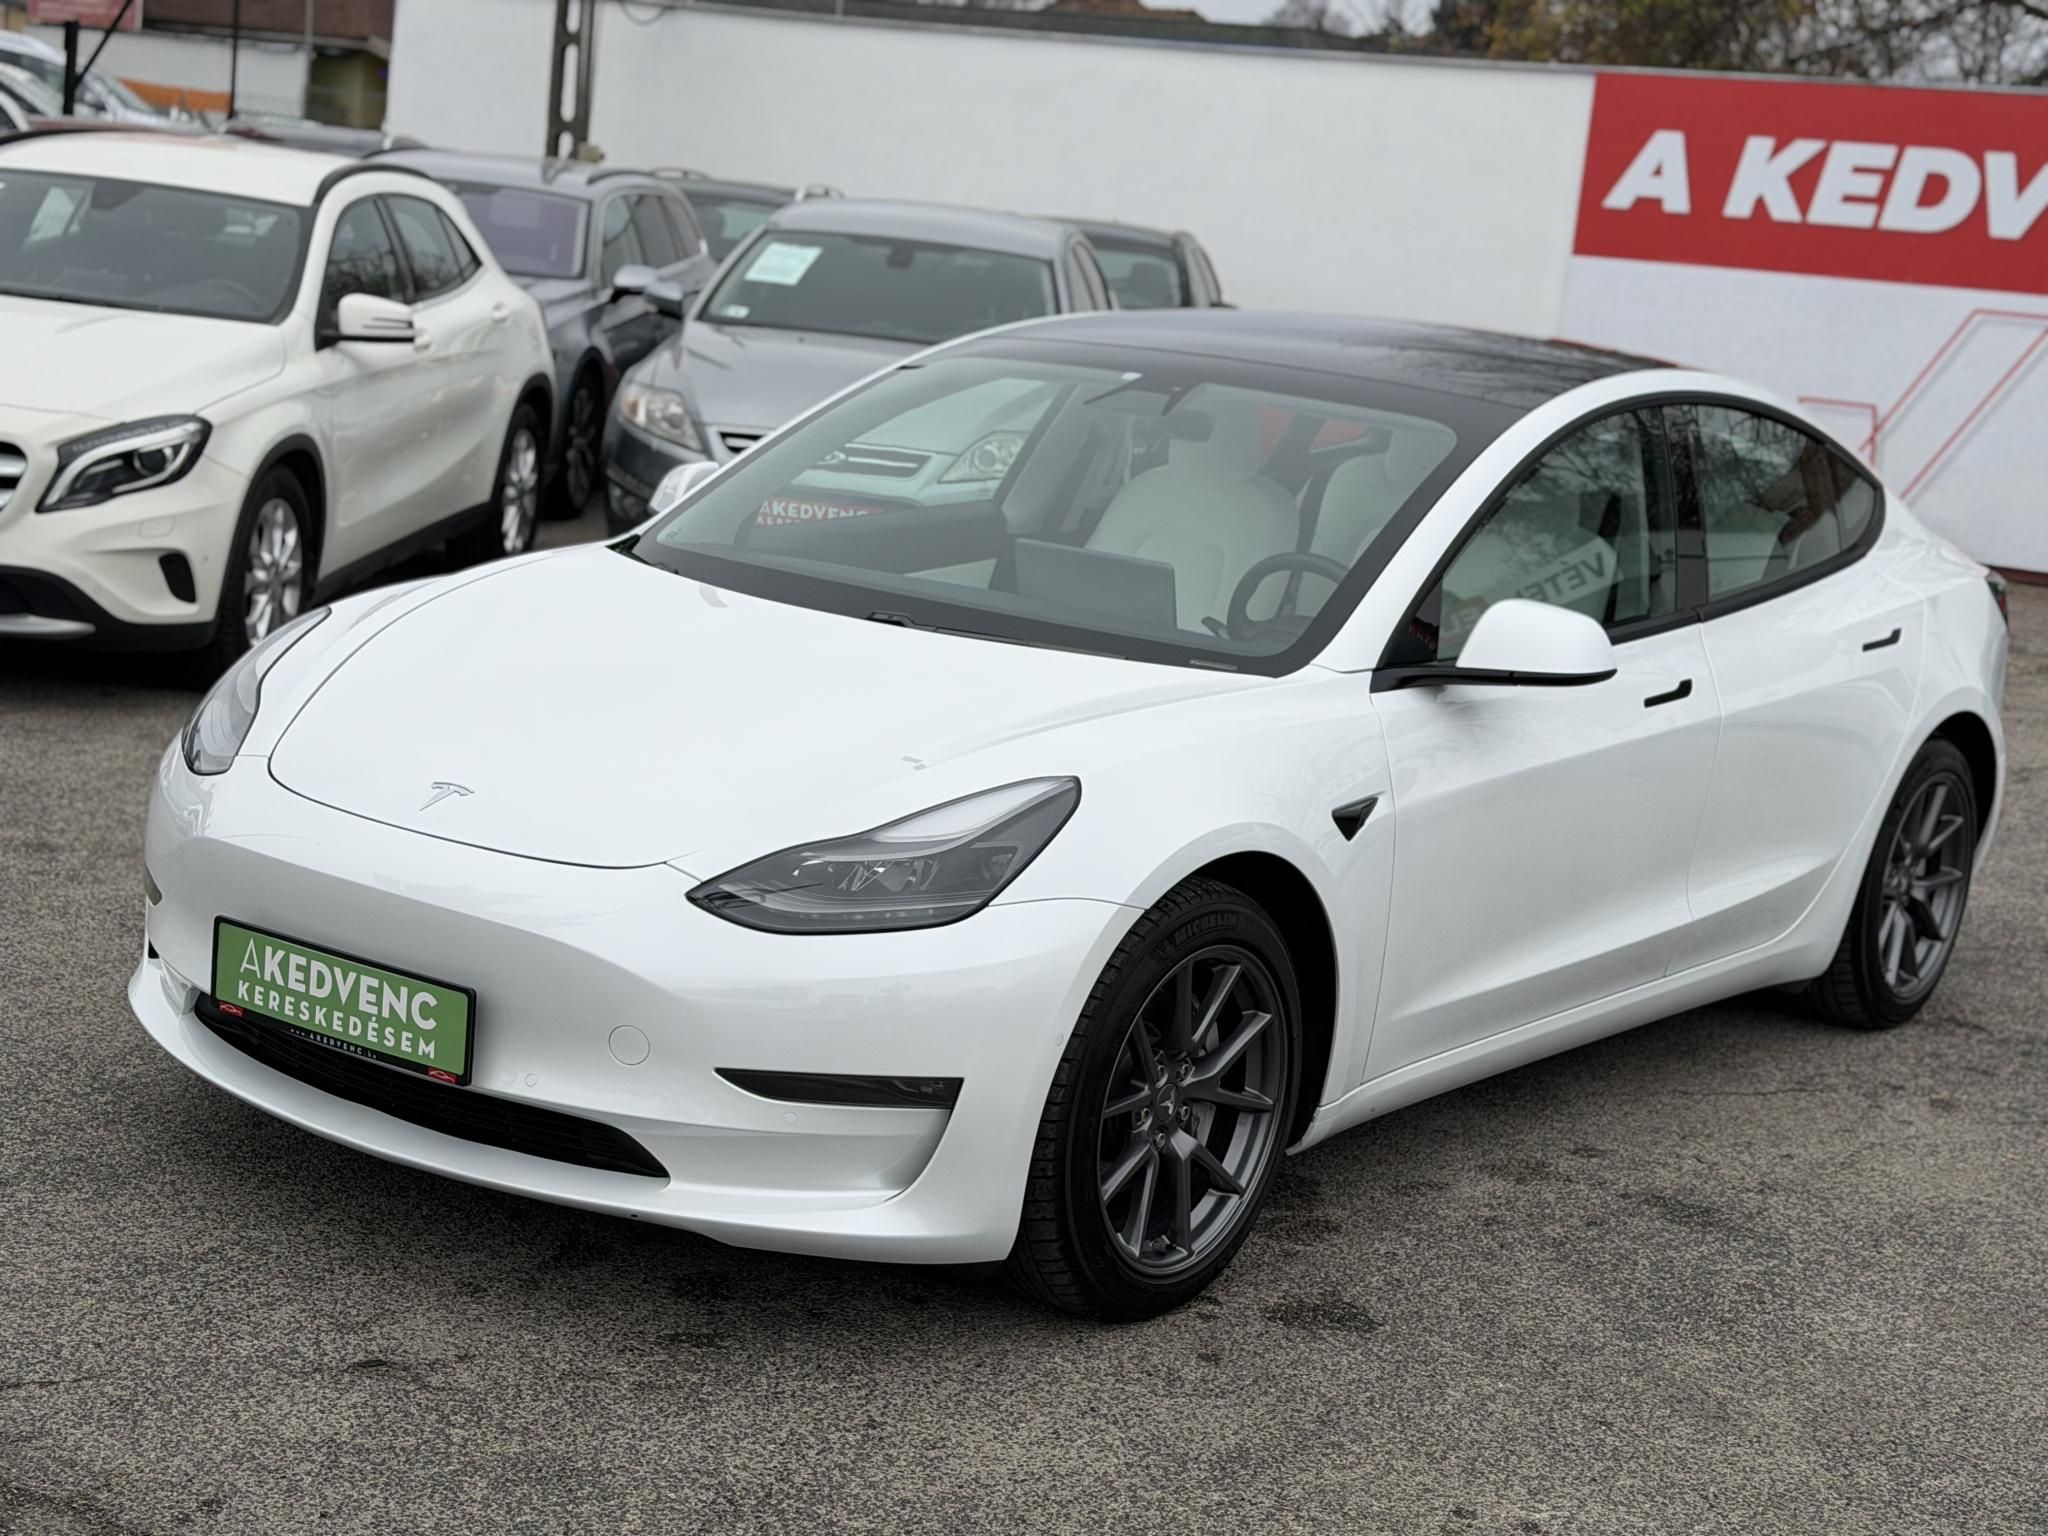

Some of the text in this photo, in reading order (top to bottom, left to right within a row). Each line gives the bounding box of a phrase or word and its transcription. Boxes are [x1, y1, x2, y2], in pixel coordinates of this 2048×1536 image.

[1601, 129, 2048, 241] A KEDV
[1174, 912, 1239, 946] MICHELIN
[237, 979, 437, 1060] KERESKEDÉSEM
